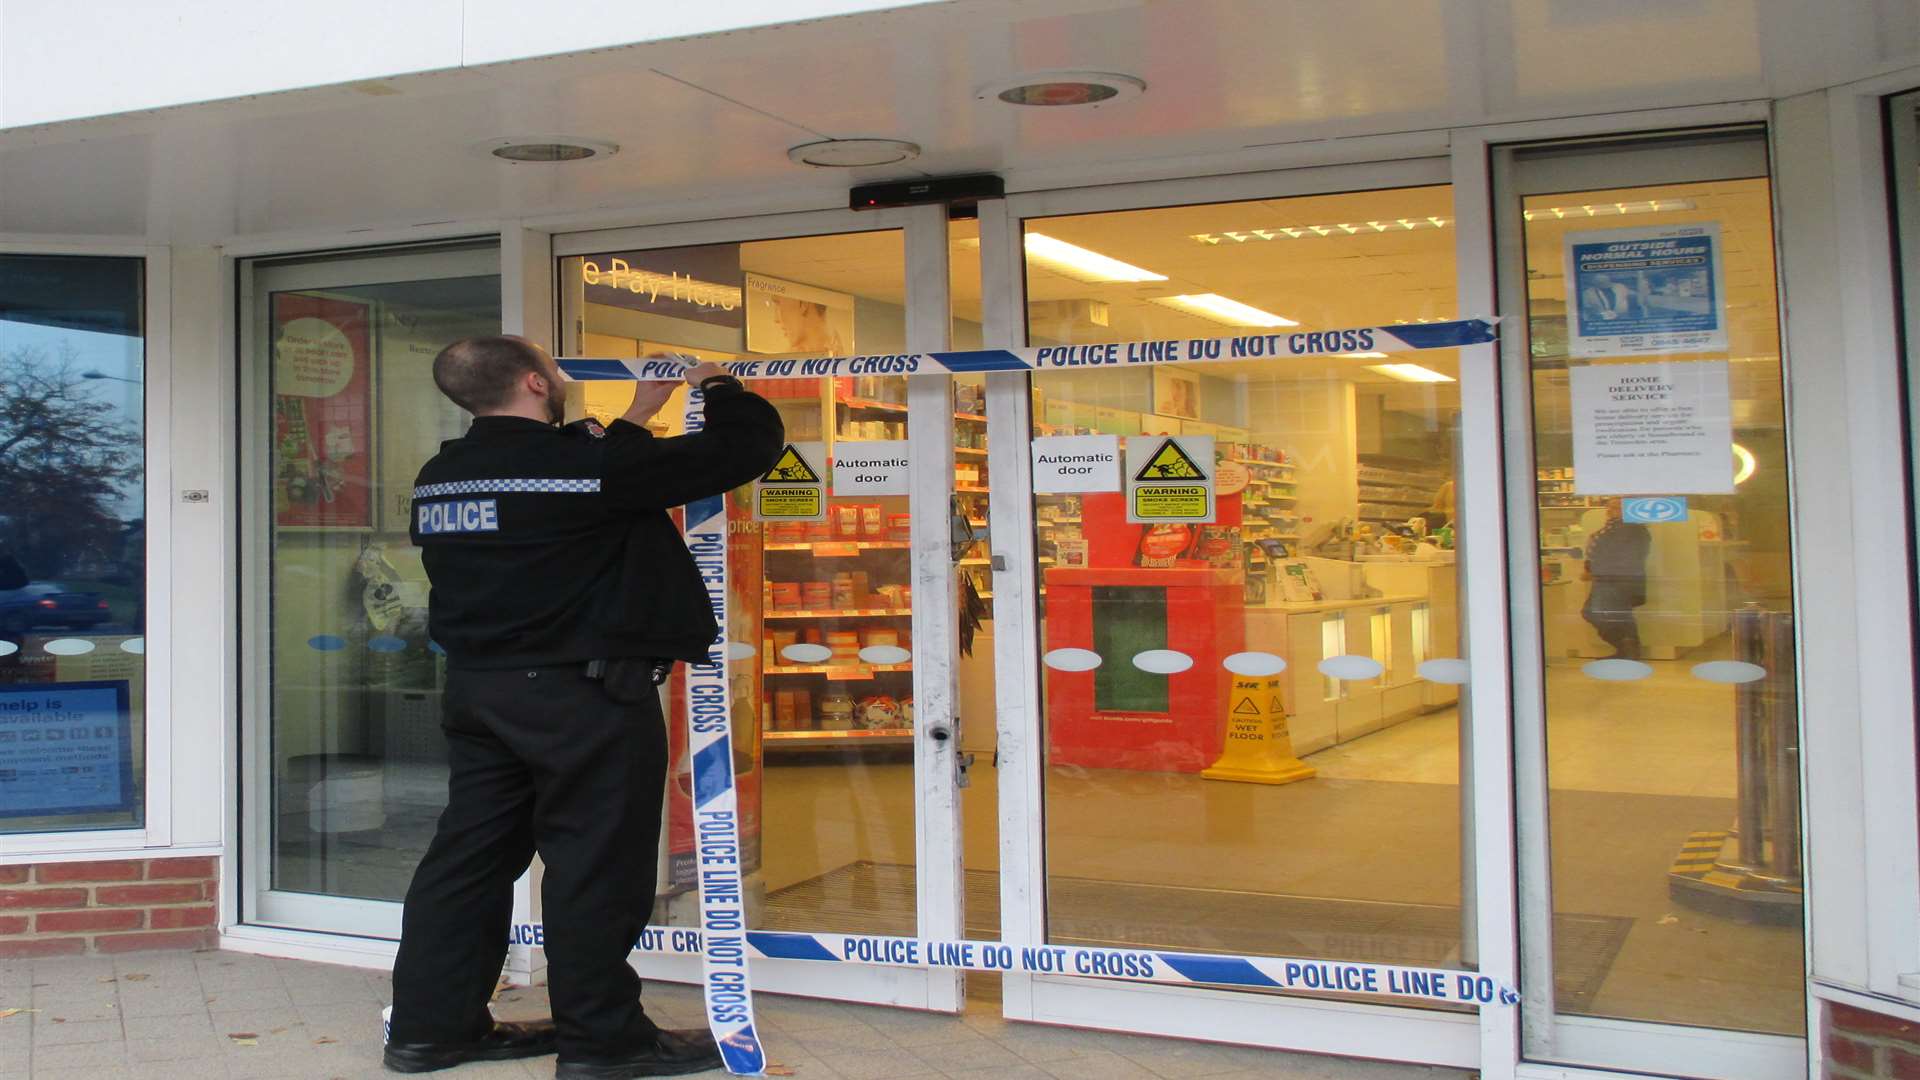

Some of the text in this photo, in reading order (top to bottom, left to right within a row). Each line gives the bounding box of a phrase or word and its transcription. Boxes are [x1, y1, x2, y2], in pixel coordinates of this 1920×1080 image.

[1607, 240, 1678, 252] OUTSIDE
[1581, 246, 1706, 261] NORMAL HOURS
[612, 257, 658, 304] Pay
[1036, 328, 1375, 366] POLICE LINE DO NOT CROSS
[722, 360, 763, 376] INE
[765, 360, 793, 375] DO
[800, 357, 848, 375] NOT
[849, 354, 921, 373] CROSS
[1620, 376, 1660, 384] HOME
[1608, 384, 1674, 393] DELIVERY
[1611, 393, 1668, 401] SERVICE
[835, 458, 908, 468] Automatic
[1038, 453, 1113, 464] Automatic
[1058, 466, 1093, 475] door
[855, 474, 888, 483] door
[418, 501, 498, 533] POLICE
[728, 518, 760, 536] price
[47, 698, 63, 710] is
[691, 685, 727, 733] CROSS
[1229, 732, 1265, 741] FLOOR
[699, 811, 749, 1024] POLICE LINE DO NOT CROSS
[672, 930, 703, 953] CR
[843, 938, 919, 964] POLICE
[927, 942, 974, 967] LINE
[982, 945, 1013, 970] DO
[1022, 947, 1066, 972] NOT
[1074, 950, 1154, 978] CROSS
[1285, 962, 1378, 992] POLICE
[1388, 969, 1446, 997] LINE
[1457, 975, 1494, 1003] DO
